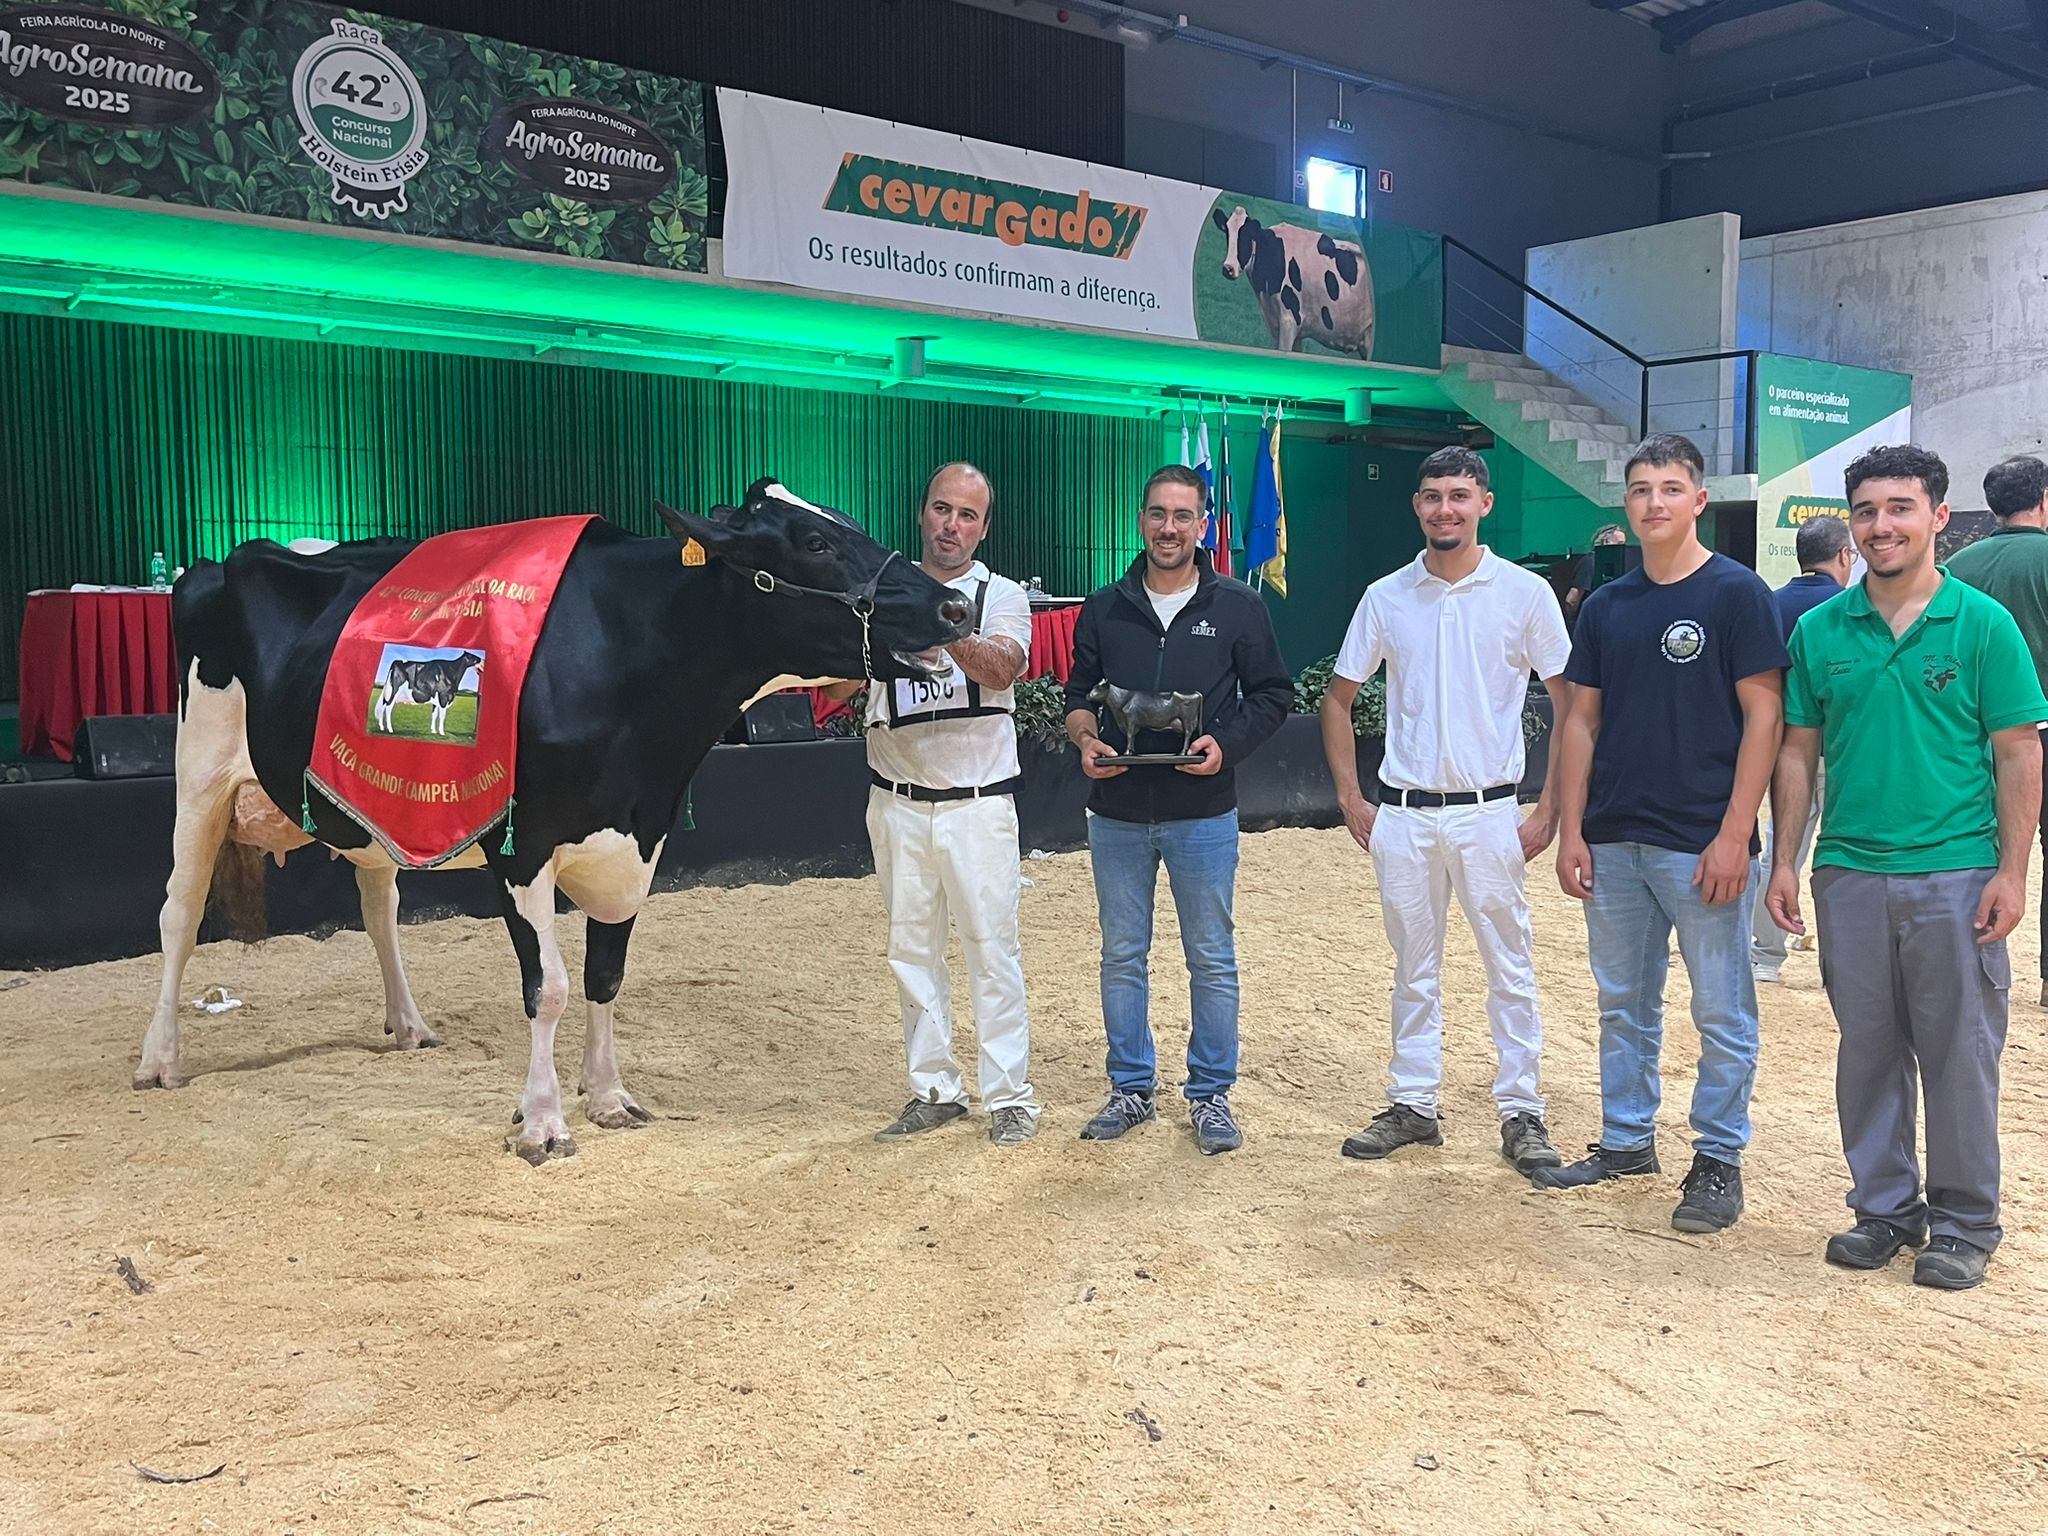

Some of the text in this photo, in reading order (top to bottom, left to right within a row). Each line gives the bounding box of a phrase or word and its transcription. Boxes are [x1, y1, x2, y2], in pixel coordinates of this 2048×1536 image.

[20, 16, 167, 50] FEIRA AGRÍCOLA DO NORTE
[335, 22, 379, 45] Raça
[64, 85, 131, 113] 2025
[331, 115, 392, 136] Concurso
[531, 107, 637, 137] FEIRA AGRÍCOLA DO NORTE
[332, 129, 393, 150] Nacional
[505, 120, 664, 172] AgroSemana
[303, 135, 425, 184] Holstein Frísia
[564, 167, 611, 191] 2025
[808, 237, 1161, 312] Os resultados confirmam a diferença.
[1769, 384, 1850, 407] O parceiro especializado
[1769, 404, 1850, 425] em alimentação animal.
[1768, 543, 1779, 557] Os
[488, 579, 506, 596] DA
[329, 733, 358, 772] VACA
[358, 762, 404, 796] GRANDE
[406, 780, 459, 803] CAMPEÃ
